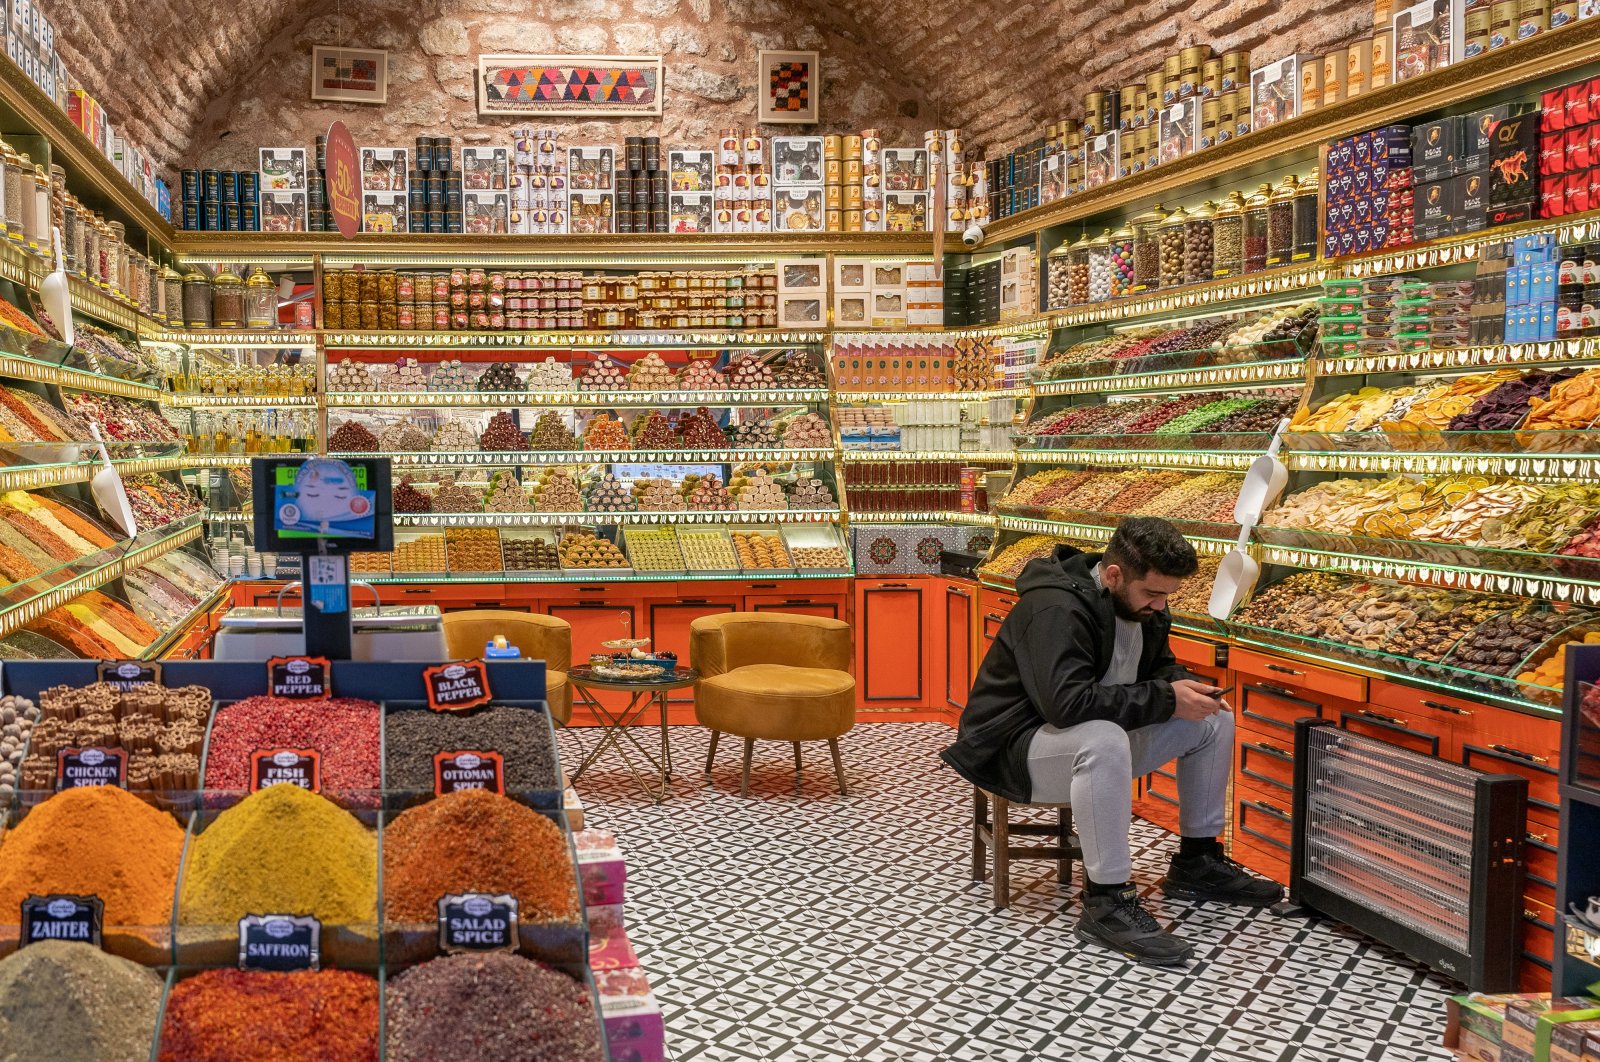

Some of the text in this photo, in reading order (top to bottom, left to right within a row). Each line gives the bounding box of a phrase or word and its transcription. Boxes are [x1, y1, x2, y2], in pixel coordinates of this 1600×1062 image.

[1477, 137, 1490, 146] MA
[1424, 146, 1442, 157] MAX
[1464, 197, 1481, 207] MAX
[1424, 206, 1442, 216] MAX
[285, 675, 312, 685] RED
[437, 677, 477, 691] BLACK
[274, 684, 322, 695] PEPPER
[436, 686, 483, 702] PEPPER
[65, 766, 118, 778] CHICKEN
[266, 767, 305, 778] FISH
[442, 769, 495, 780] OTTOMAN
[452, 781, 485, 791] SPICE
[31, 920, 89, 938] ZAHTER
[450, 918, 506, 930] SALAD
[453, 930, 504, 943] SPICE
[247, 943, 309, 957] SAFFRON
